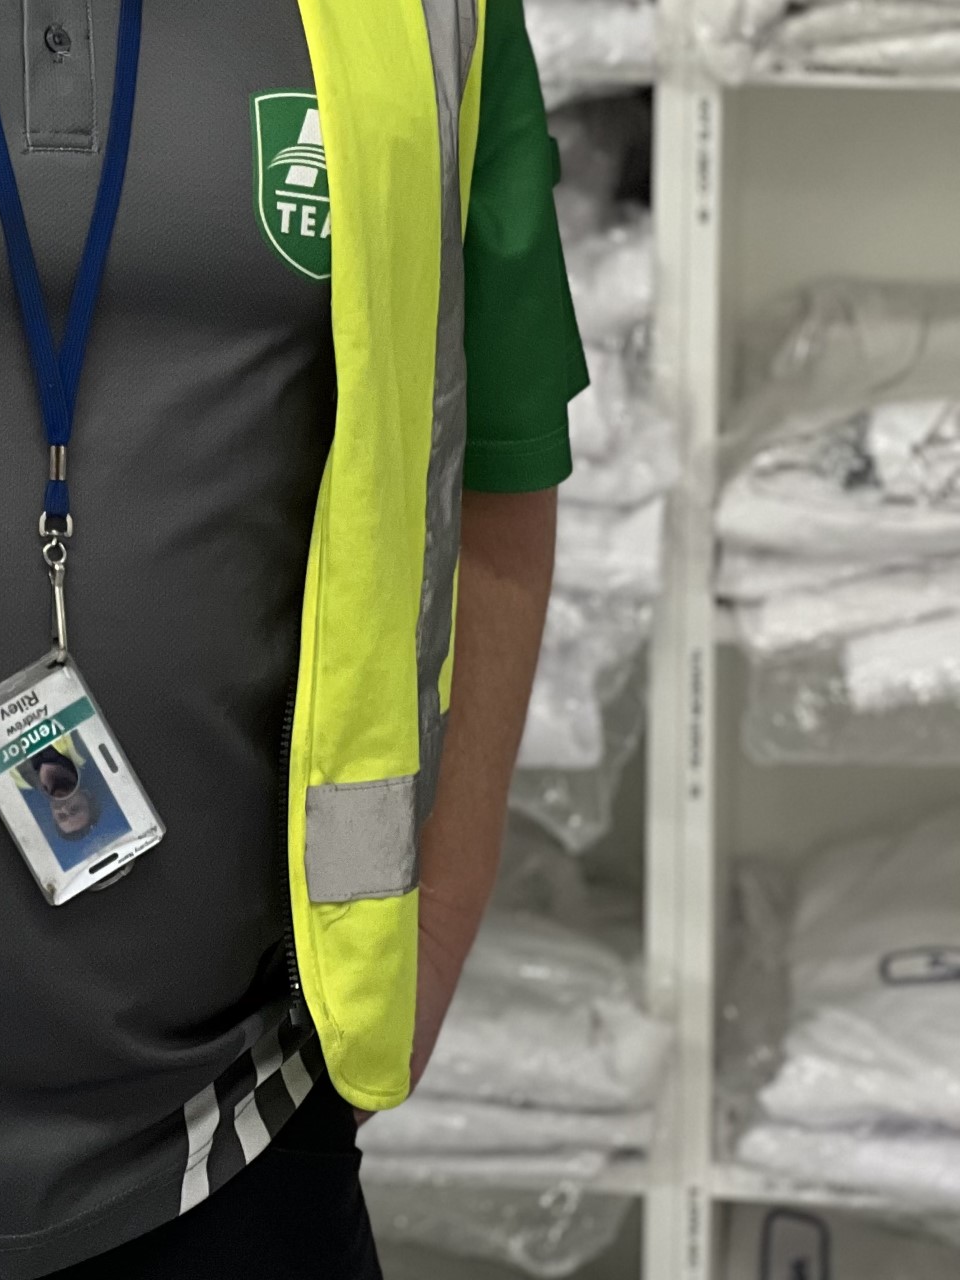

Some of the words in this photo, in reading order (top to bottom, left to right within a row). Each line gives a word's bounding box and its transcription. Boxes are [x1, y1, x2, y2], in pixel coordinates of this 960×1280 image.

[0, 690, 39, 721] Riley
[6, 704, 48, 737] Andrew
[2, 719, 65, 763] Vendor
